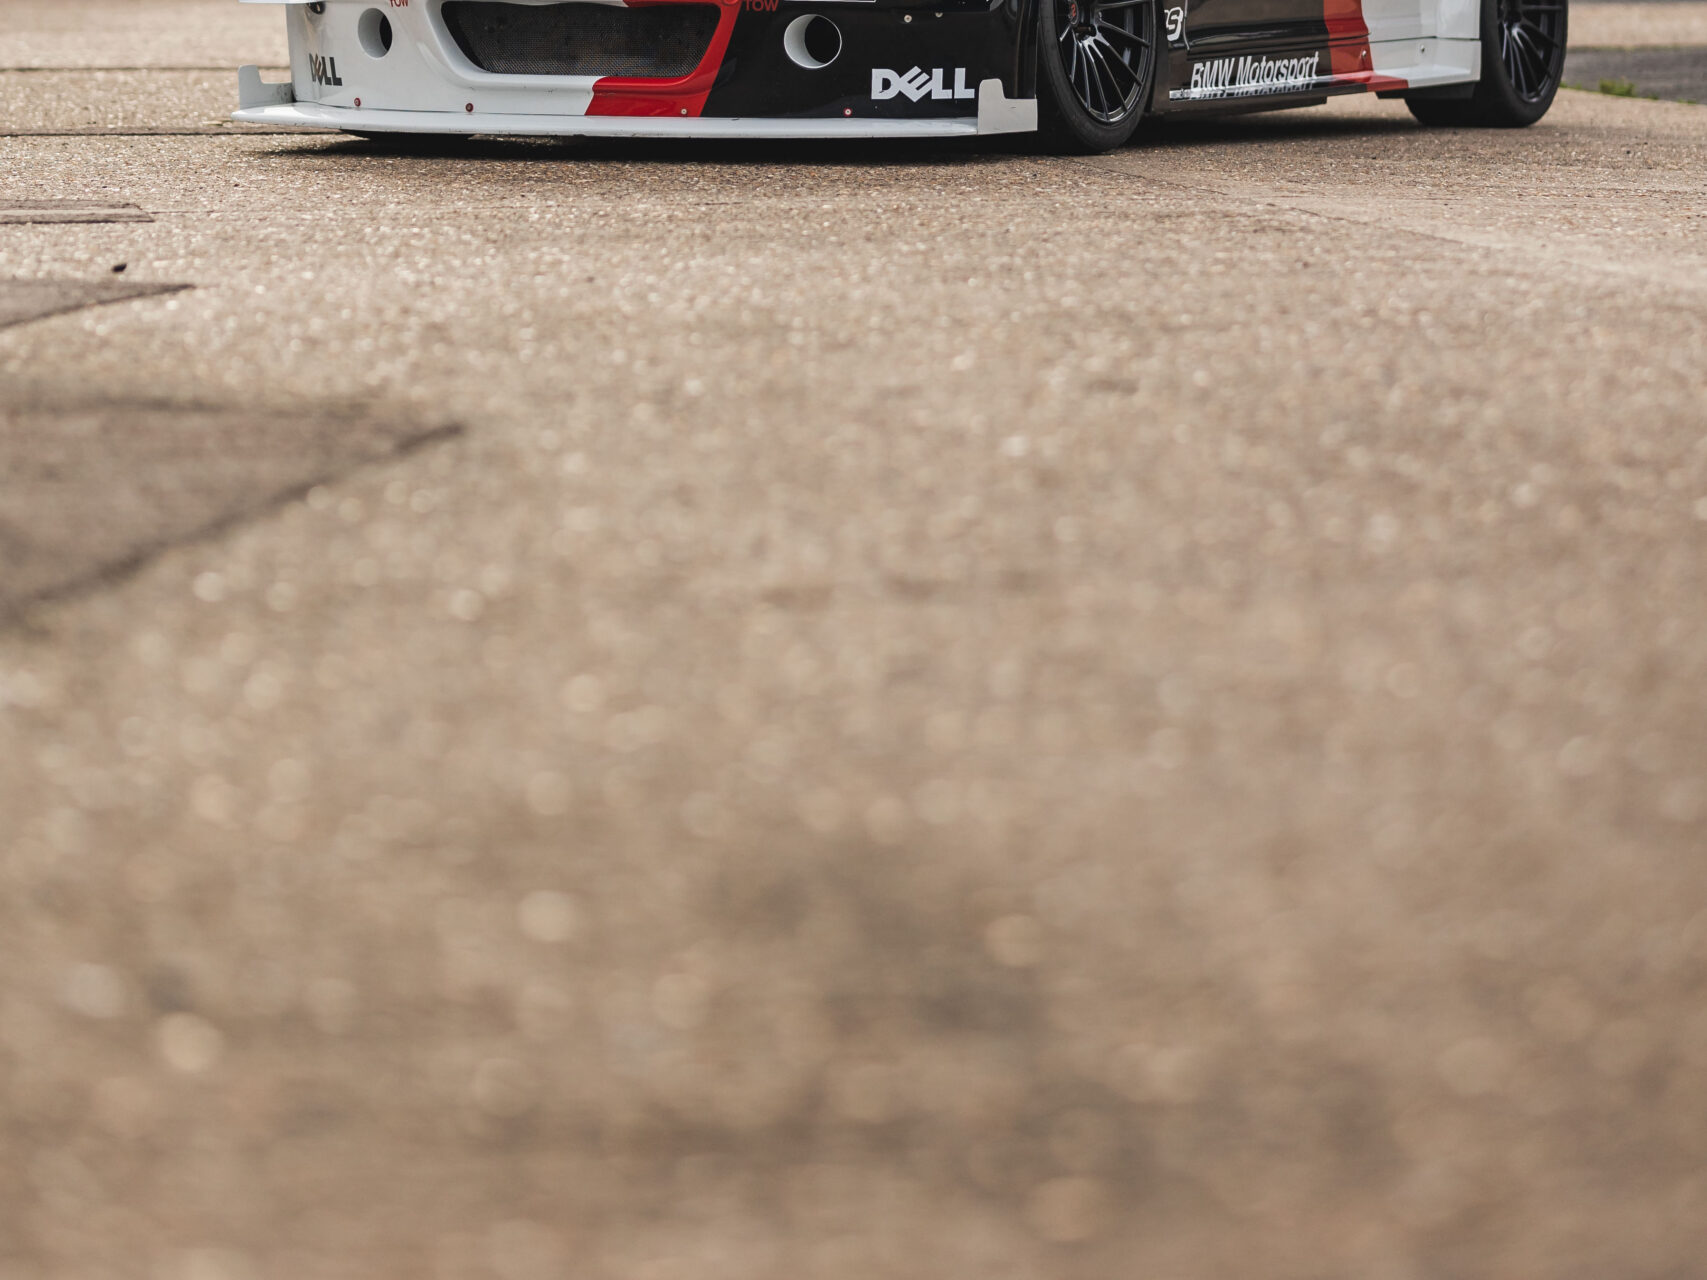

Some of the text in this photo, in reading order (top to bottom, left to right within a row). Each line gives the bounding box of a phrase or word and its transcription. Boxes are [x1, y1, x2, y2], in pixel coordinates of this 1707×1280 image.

[745, 0, 779, 12] TOW
[871, 65, 976, 103] DELL
[1190, 50, 1319, 91] BMW Motorsport
